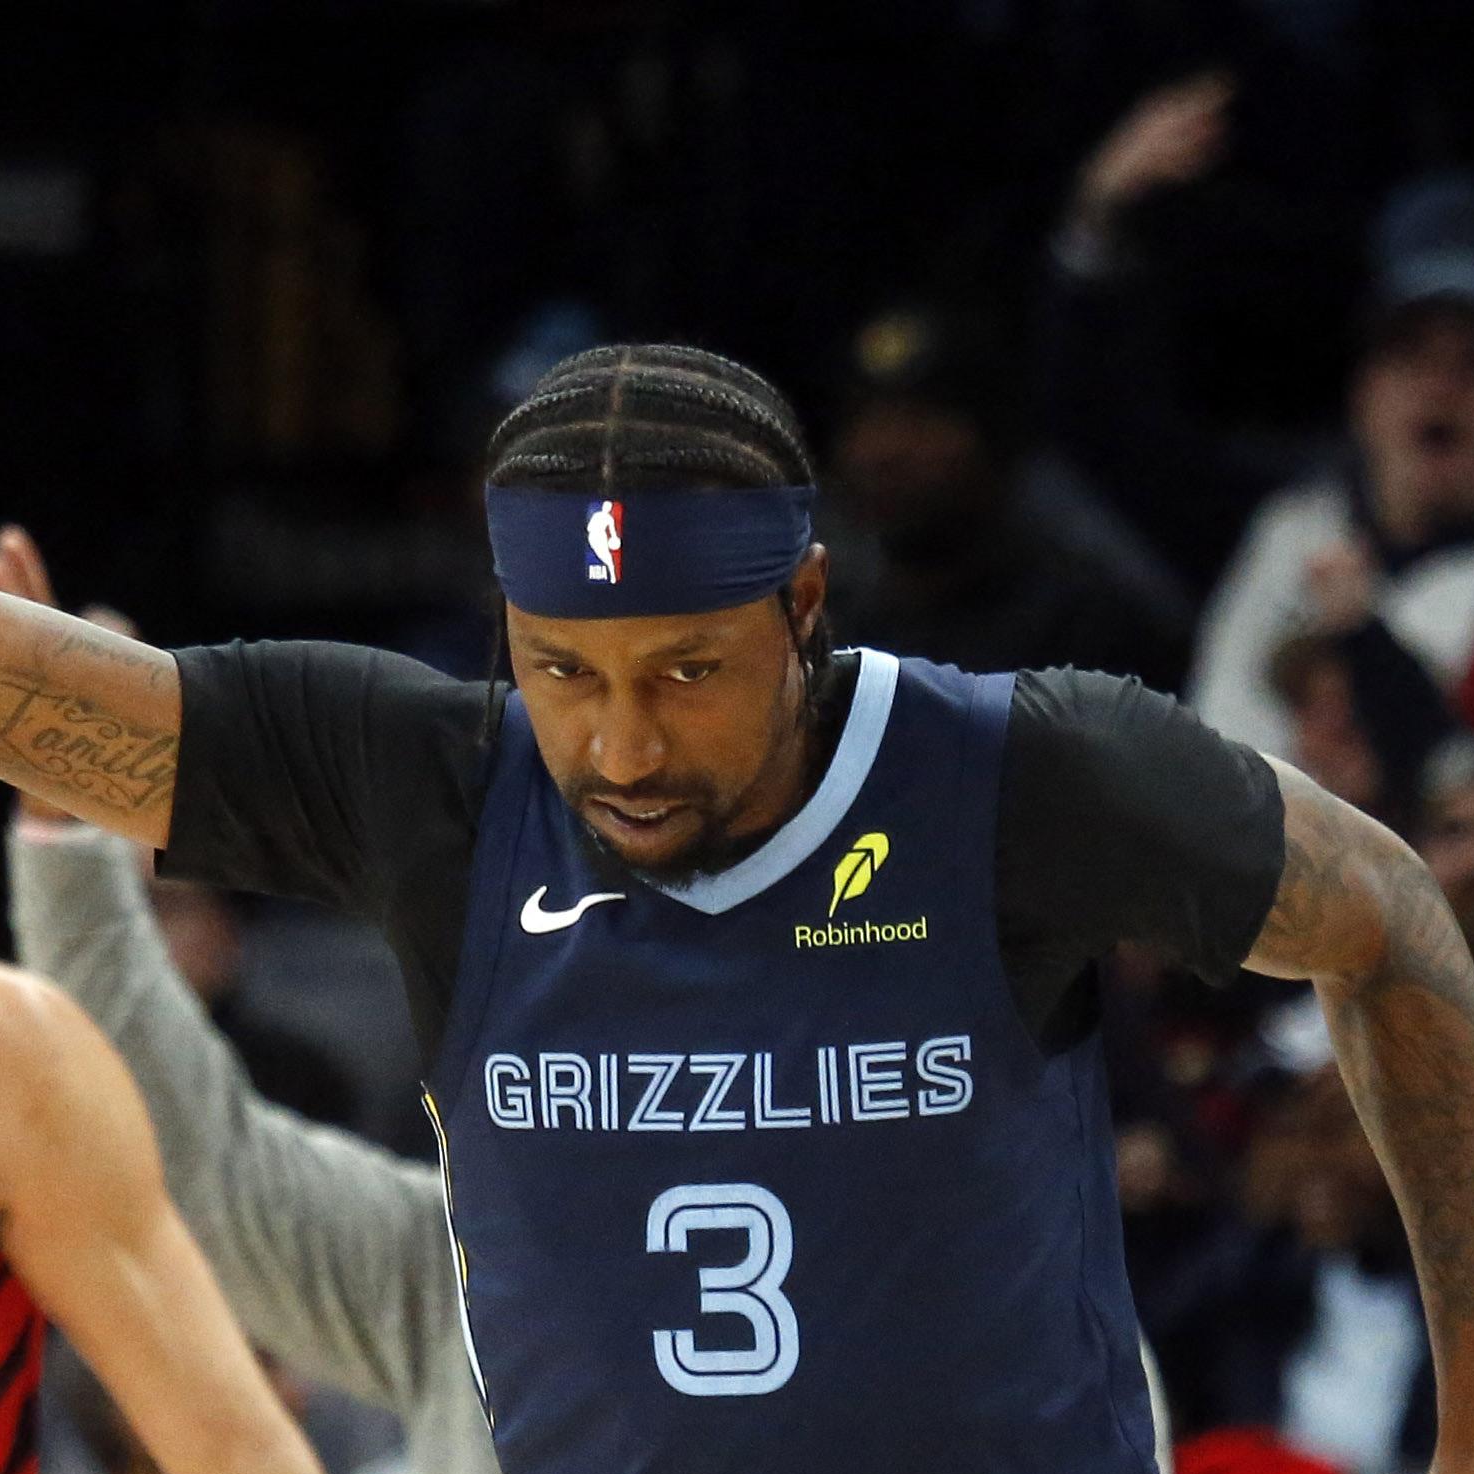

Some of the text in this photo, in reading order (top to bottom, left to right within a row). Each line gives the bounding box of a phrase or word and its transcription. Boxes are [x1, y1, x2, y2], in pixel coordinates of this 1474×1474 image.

[794, 915, 928, 949] Robinhood
[483, 1034, 975, 1132] GRIZZLIES
[645, 1182, 800, 1397] 3
